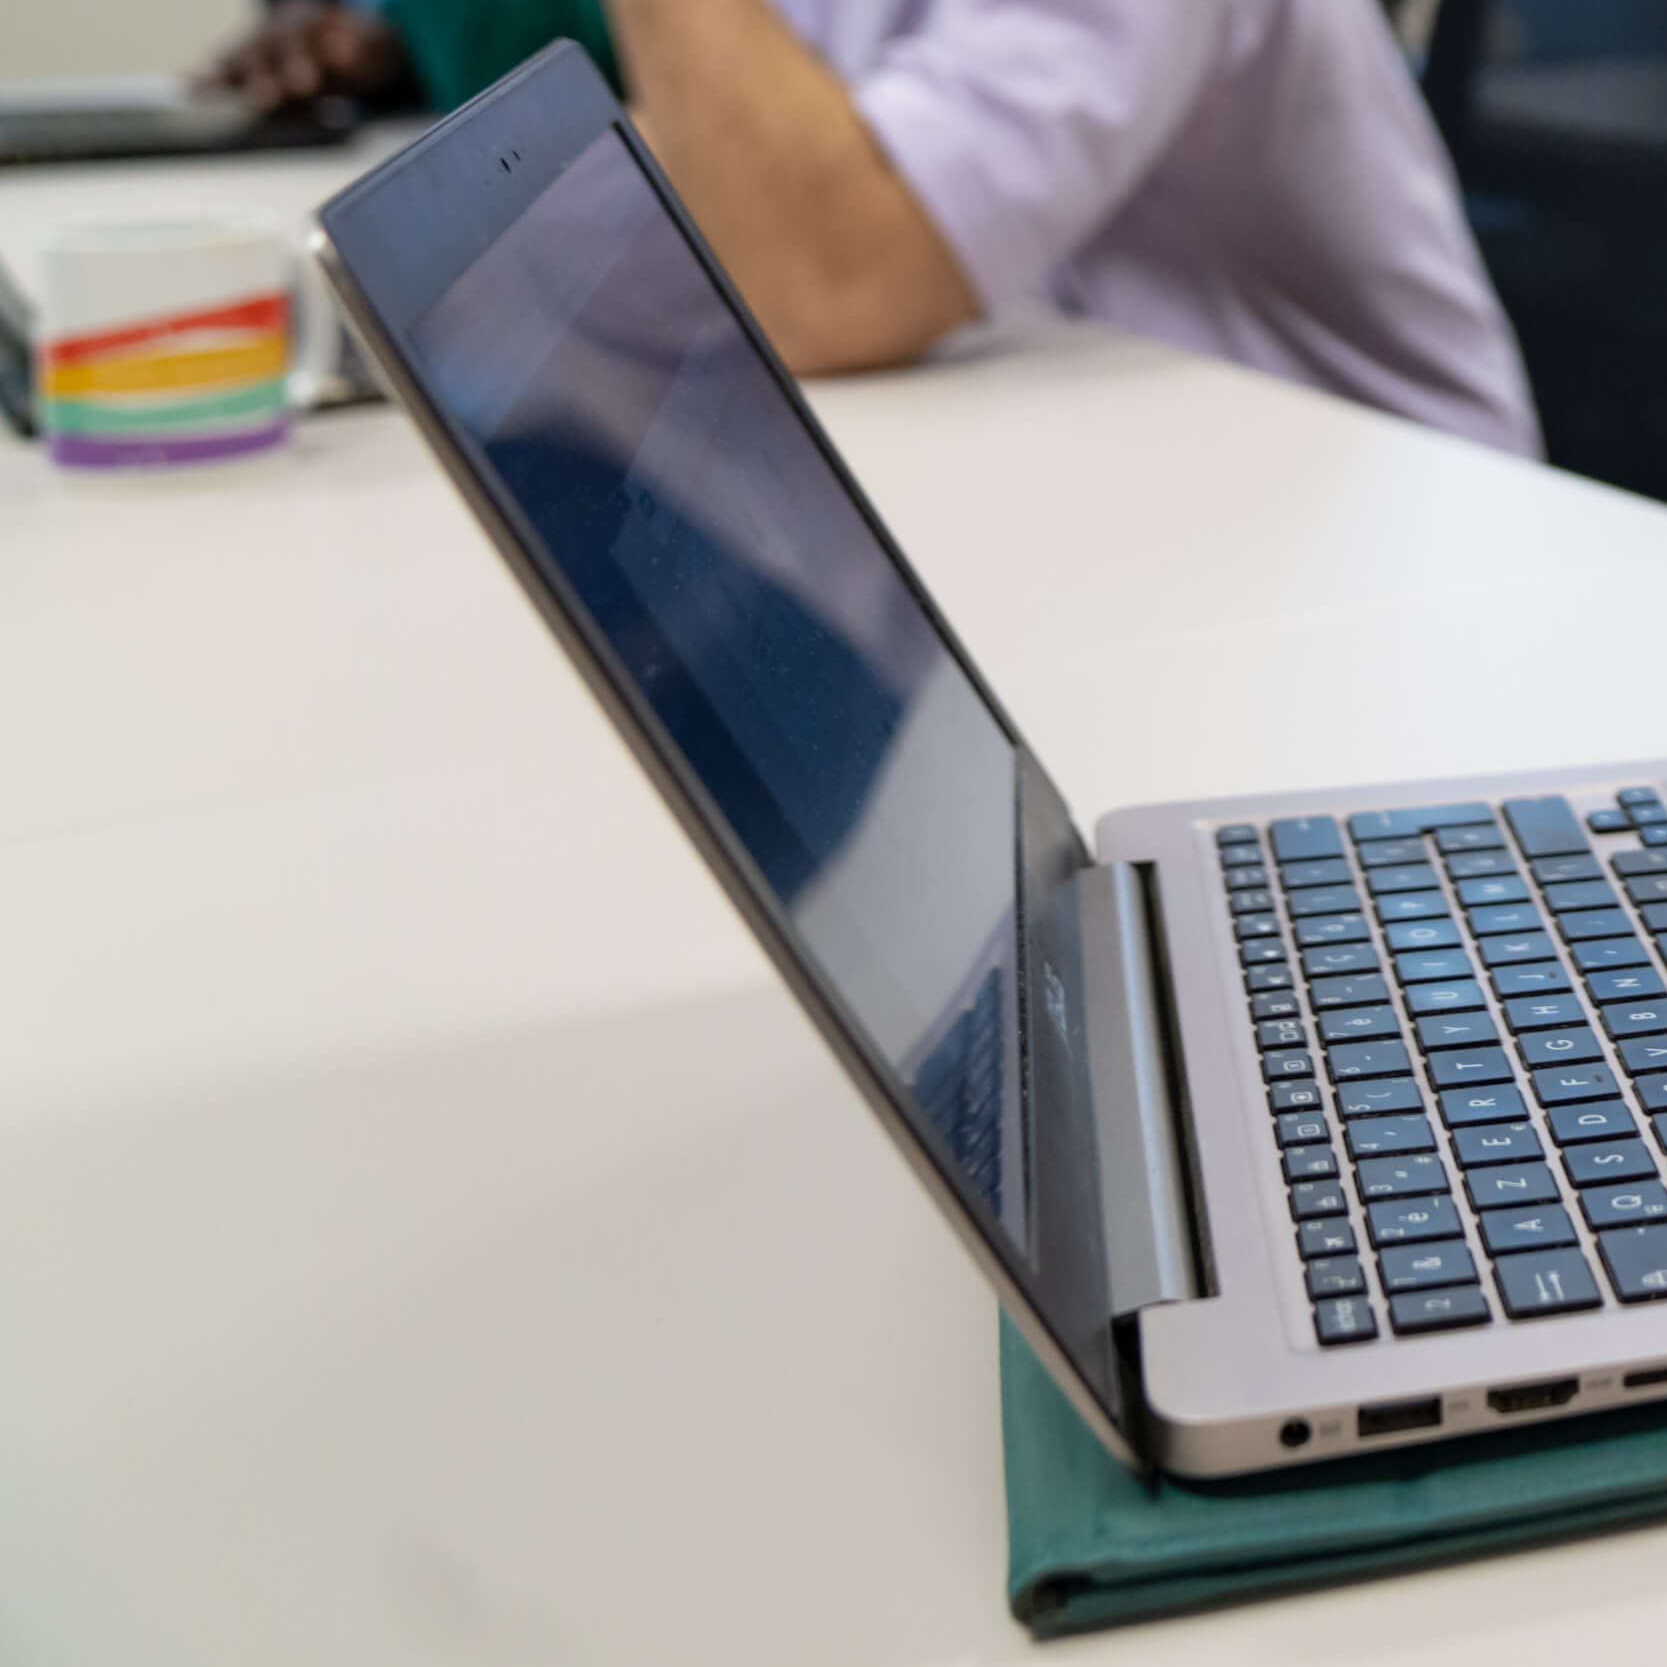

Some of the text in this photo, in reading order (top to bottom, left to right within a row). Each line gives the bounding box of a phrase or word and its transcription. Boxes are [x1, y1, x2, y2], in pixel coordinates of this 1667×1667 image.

[1408, 928, 1438, 940] O
[1504, 943, 1530, 952] K
[1612, 978, 1641, 988] N
[1431, 991, 1459, 1001] U
[1530, 1005, 1560, 1015] H
[1629, 1011, 1657, 1021] B
[1442, 1026, 1470, 1034] Y
[1545, 1039, 1574, 1051] G
[1456, 1062, 1484, 1071] T
[1560, 1078, 1589, 1087] F
[1468, 1097, 1497, 1107] R
[1348, 1103, 1372, 1112] 5
[1578, 1114, 1608, 1125] D
[1481, 1137, 1512, 1147] E
[1593, 1154, 1625, 1164] S
[1369, 1184, 1393, 1193] 3
[1496, 1177, 1527, 1190] Z
[1611, 1195, 1643, 1209] Q
[1514, 1218, 1544, 1231] A
